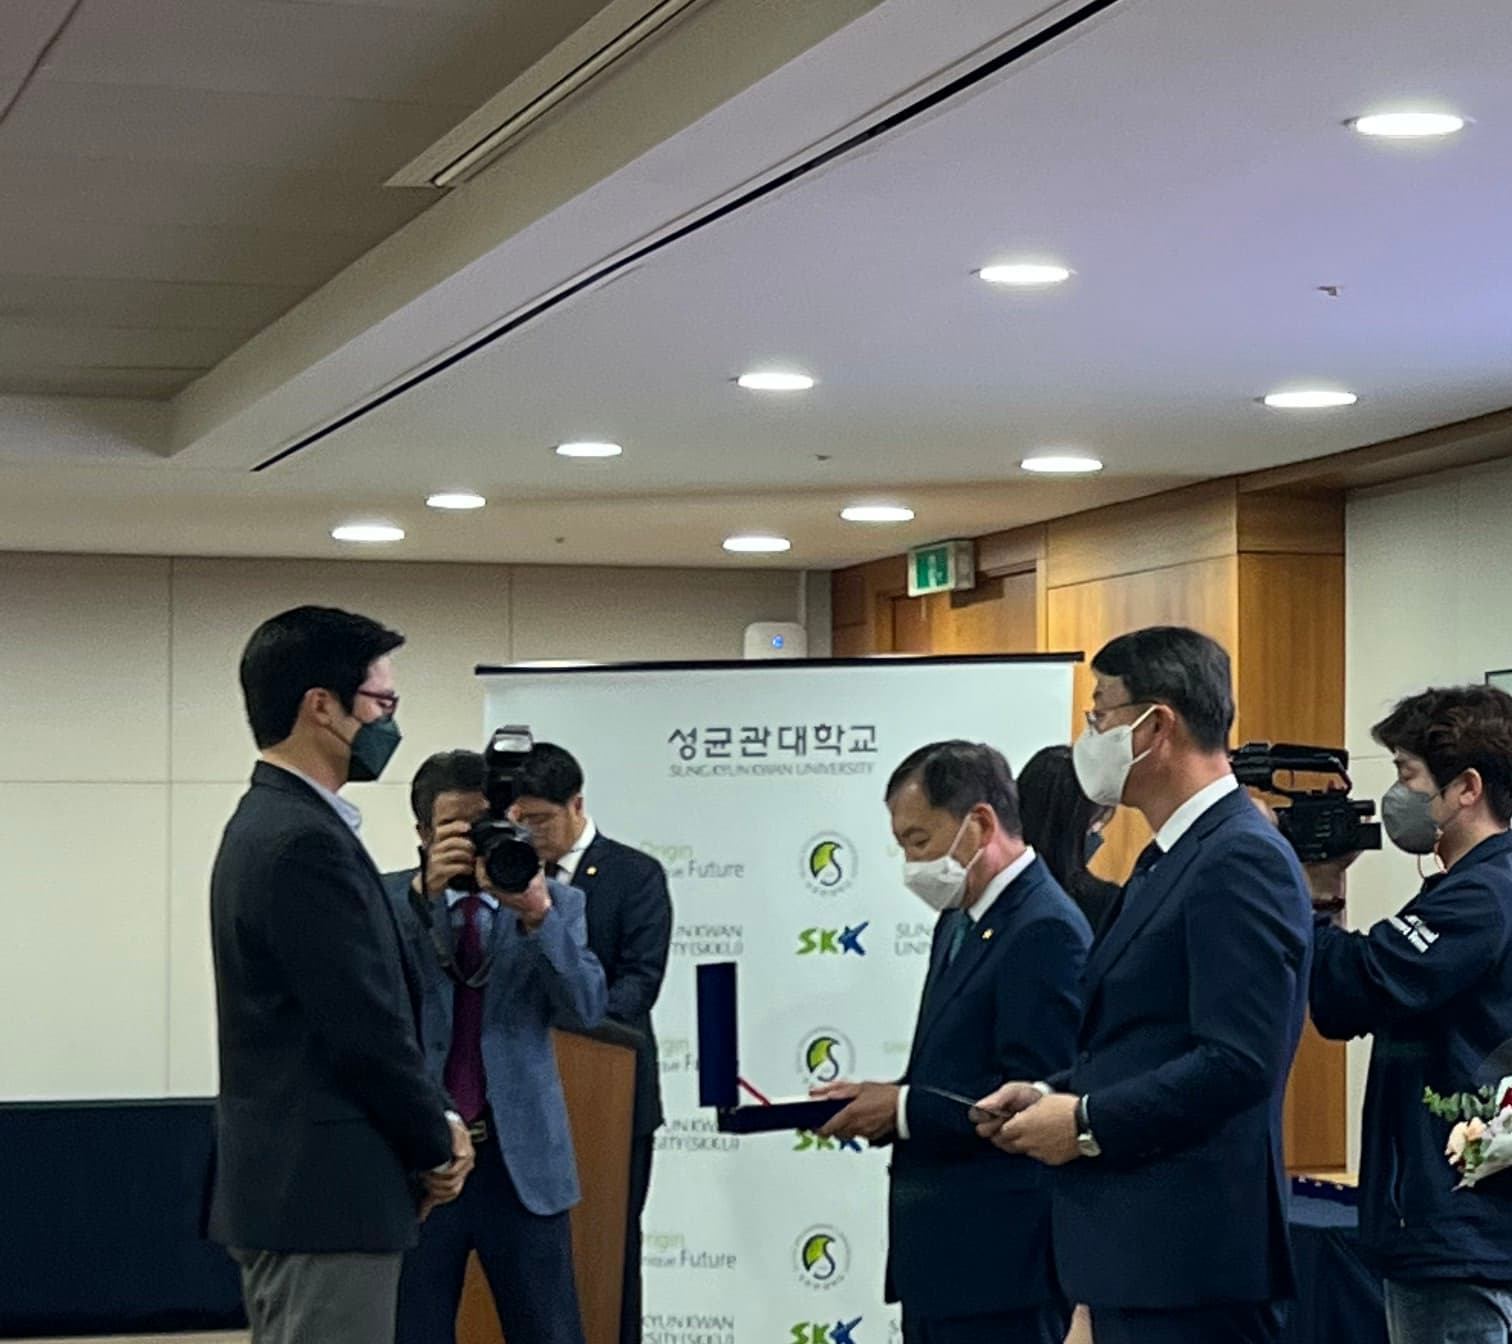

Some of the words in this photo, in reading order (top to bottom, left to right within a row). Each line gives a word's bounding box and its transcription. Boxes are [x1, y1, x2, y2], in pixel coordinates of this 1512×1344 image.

[668, 723, 878, 761] 성균관대학교
[688, 860, 745, 879] Future
[680, 1248, 737, 1270] Future
